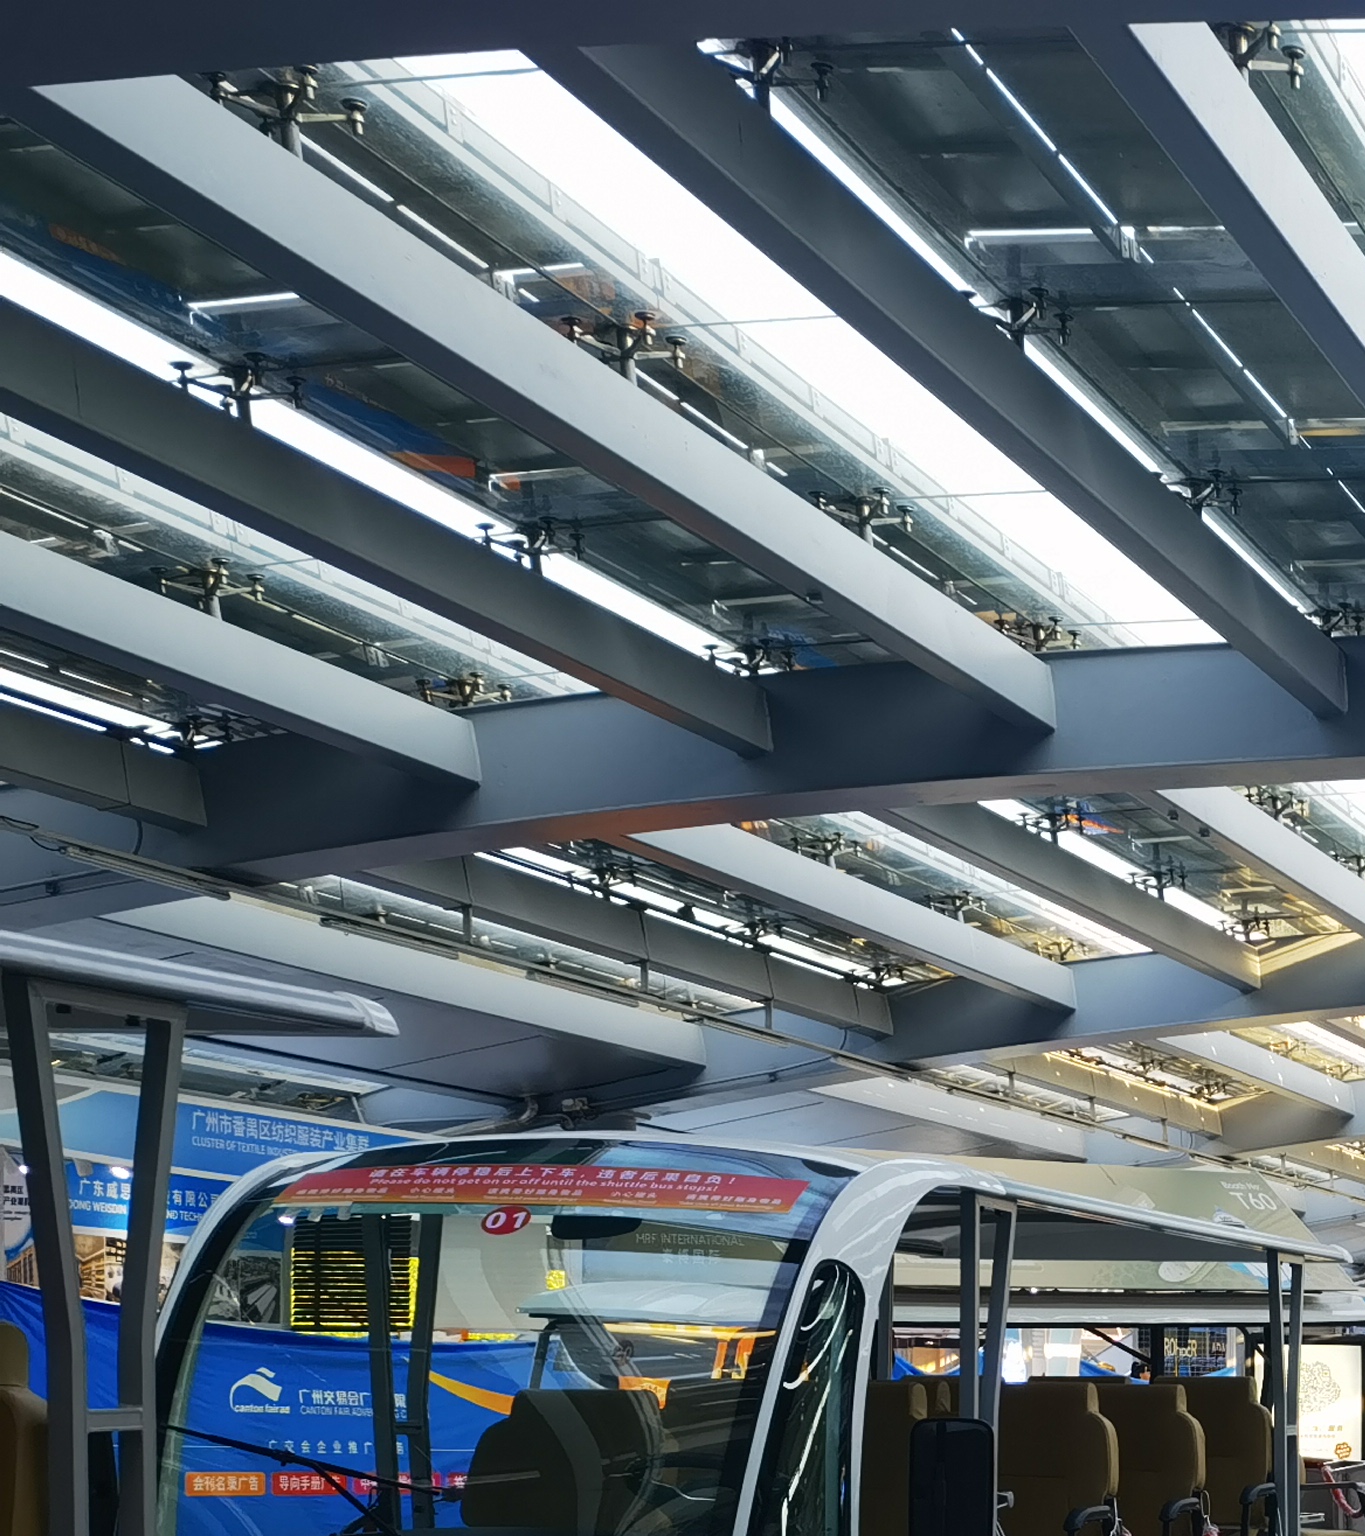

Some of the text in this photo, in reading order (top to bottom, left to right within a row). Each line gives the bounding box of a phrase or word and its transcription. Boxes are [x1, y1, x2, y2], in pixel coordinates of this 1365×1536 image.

[458, 1178, 480, 1186] get
[520, 1177, 541, 1185] off
[542, 1178, 573, 1186] until
[575, 1179, 597, 1187] the
[600, 1180, 648, 1188] shuttle
[650, 1181, 673, 1189] bus
[1229, 1192, 1277, 1210] T60
[486, 1211, 528, 1229] 01
[660, 1234, 745, 1247] INTERNATIONAL
[300, 1405, 333, 1416] CANTON
[334, 1406, 350, 1416] FAIR
